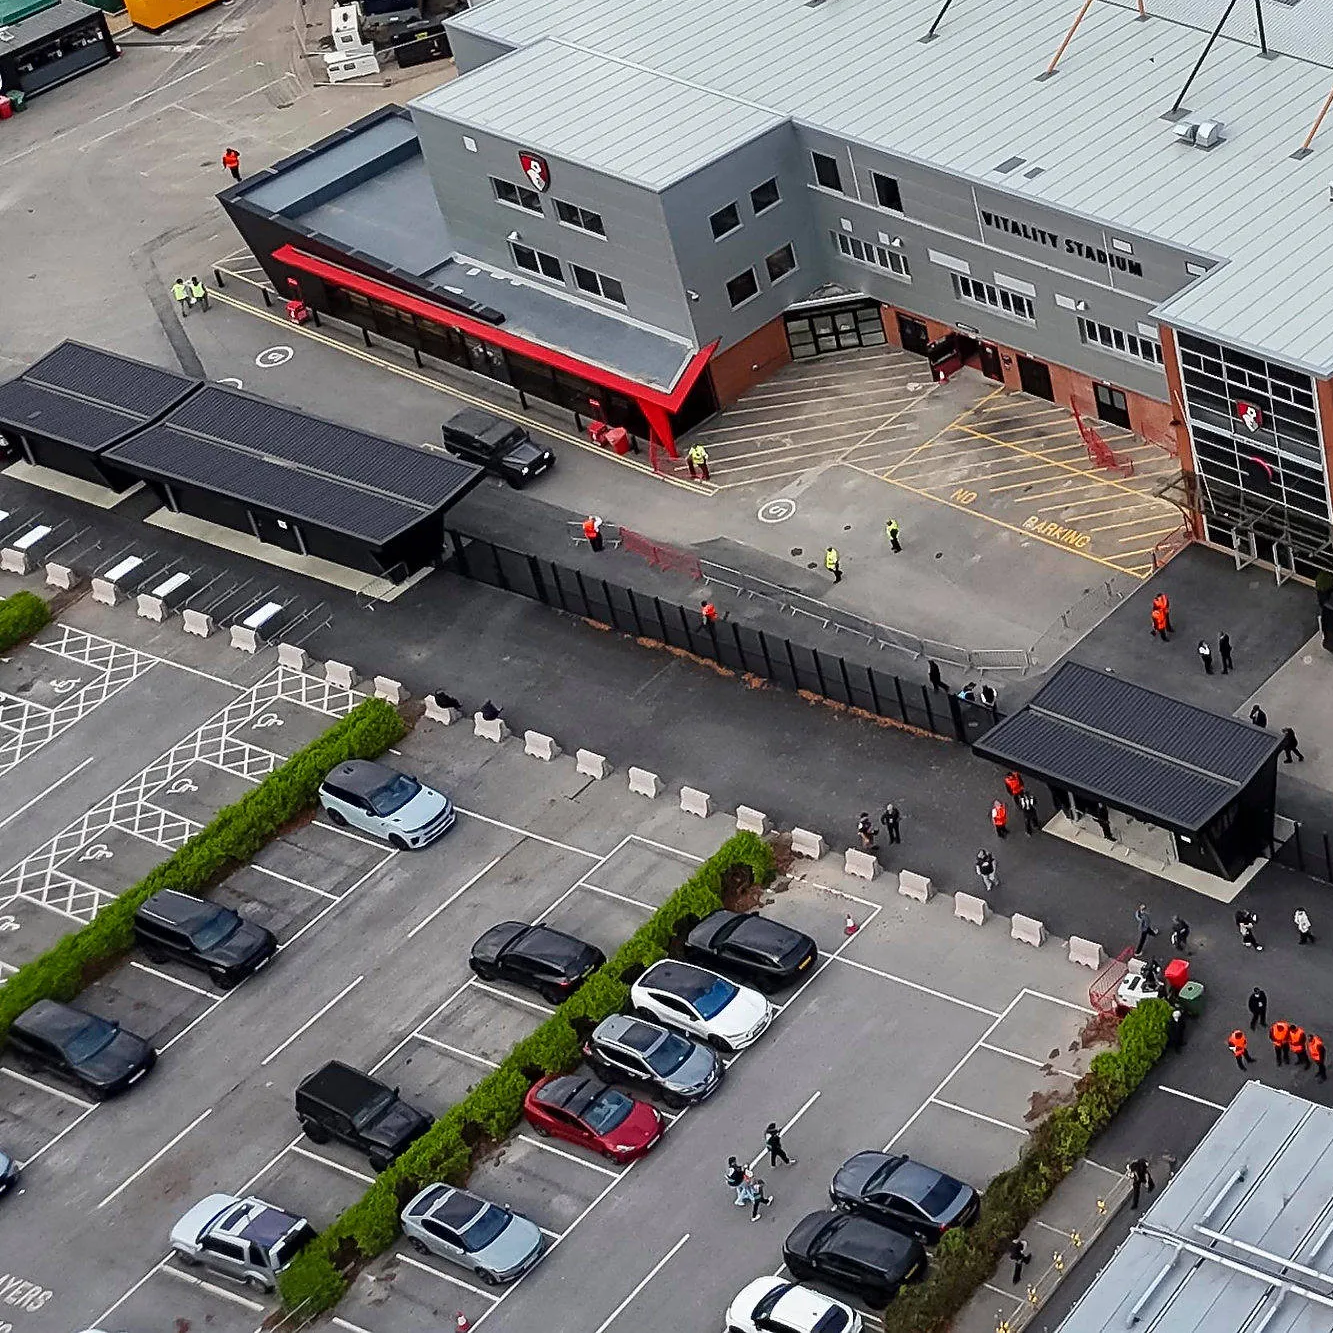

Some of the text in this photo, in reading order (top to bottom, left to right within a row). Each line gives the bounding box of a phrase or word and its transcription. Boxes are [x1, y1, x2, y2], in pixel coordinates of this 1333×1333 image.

[981, 211, 1143, 278] VITALITY STADIUM
[951, 488, 978, 505] NO
[768, 505, 786, 518] 5
[1022, 515, 1091, 548] PARKING
